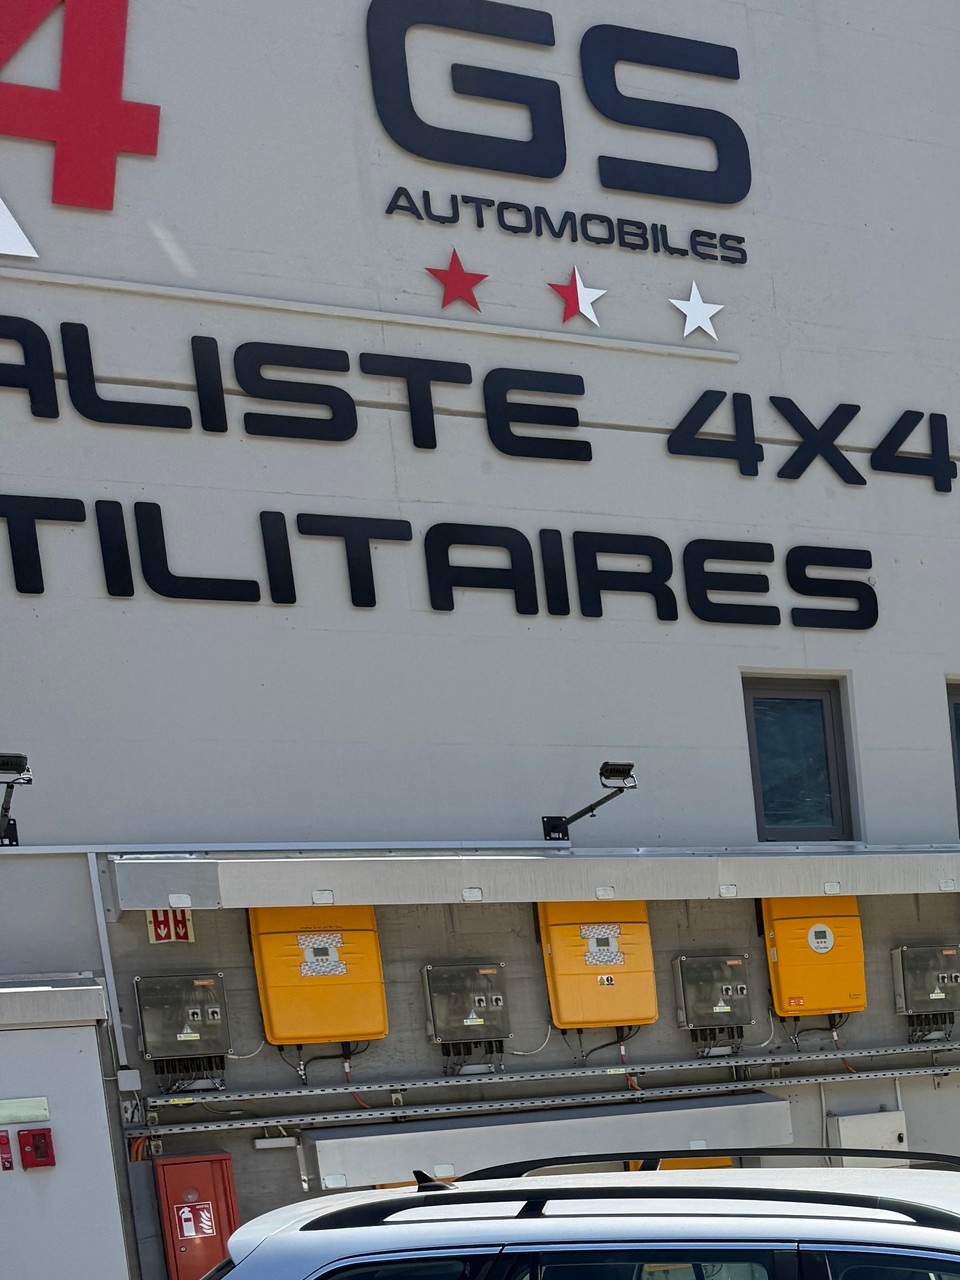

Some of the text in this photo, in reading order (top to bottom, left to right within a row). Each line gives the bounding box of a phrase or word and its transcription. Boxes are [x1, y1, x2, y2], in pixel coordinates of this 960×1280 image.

[0, 0, 161, 211] 4
[366, 0, 752, 205] GS
[385, 186, 748, 265] AUTOMOBILES
[667, 389, 958, 493] 4X4
[0, 494, 879, 631] TILITAIRES
